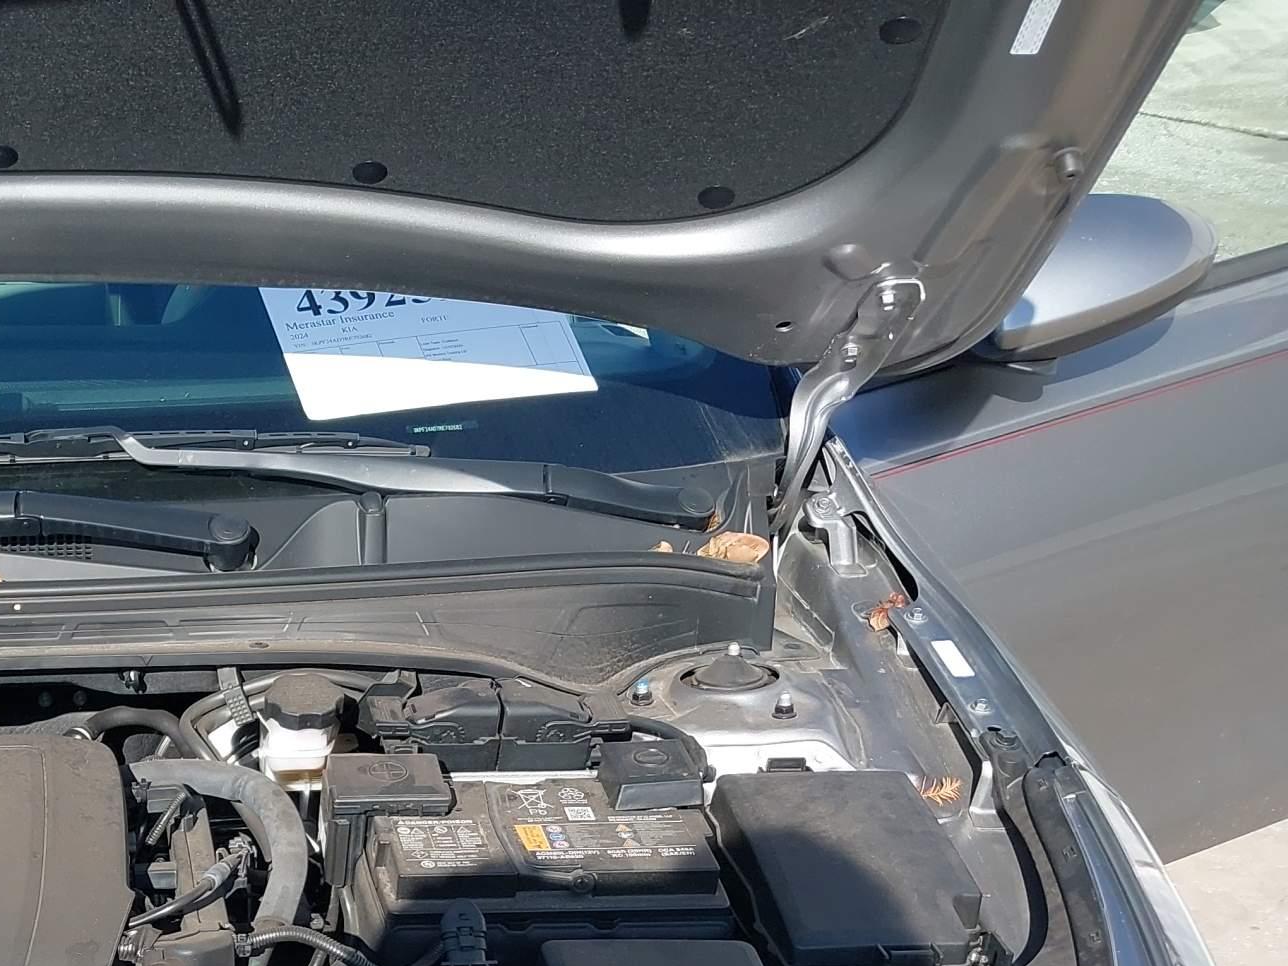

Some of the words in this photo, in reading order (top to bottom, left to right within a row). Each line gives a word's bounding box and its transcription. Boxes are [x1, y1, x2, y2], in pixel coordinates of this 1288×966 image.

[285, 318, 337, 331] Merastar
[339, 311, 394, 324] Insurance
[341, 326, 358, 334] KIA
[290, 332, 309, 341] 2024
[528, 808, 547, 816] Pb
